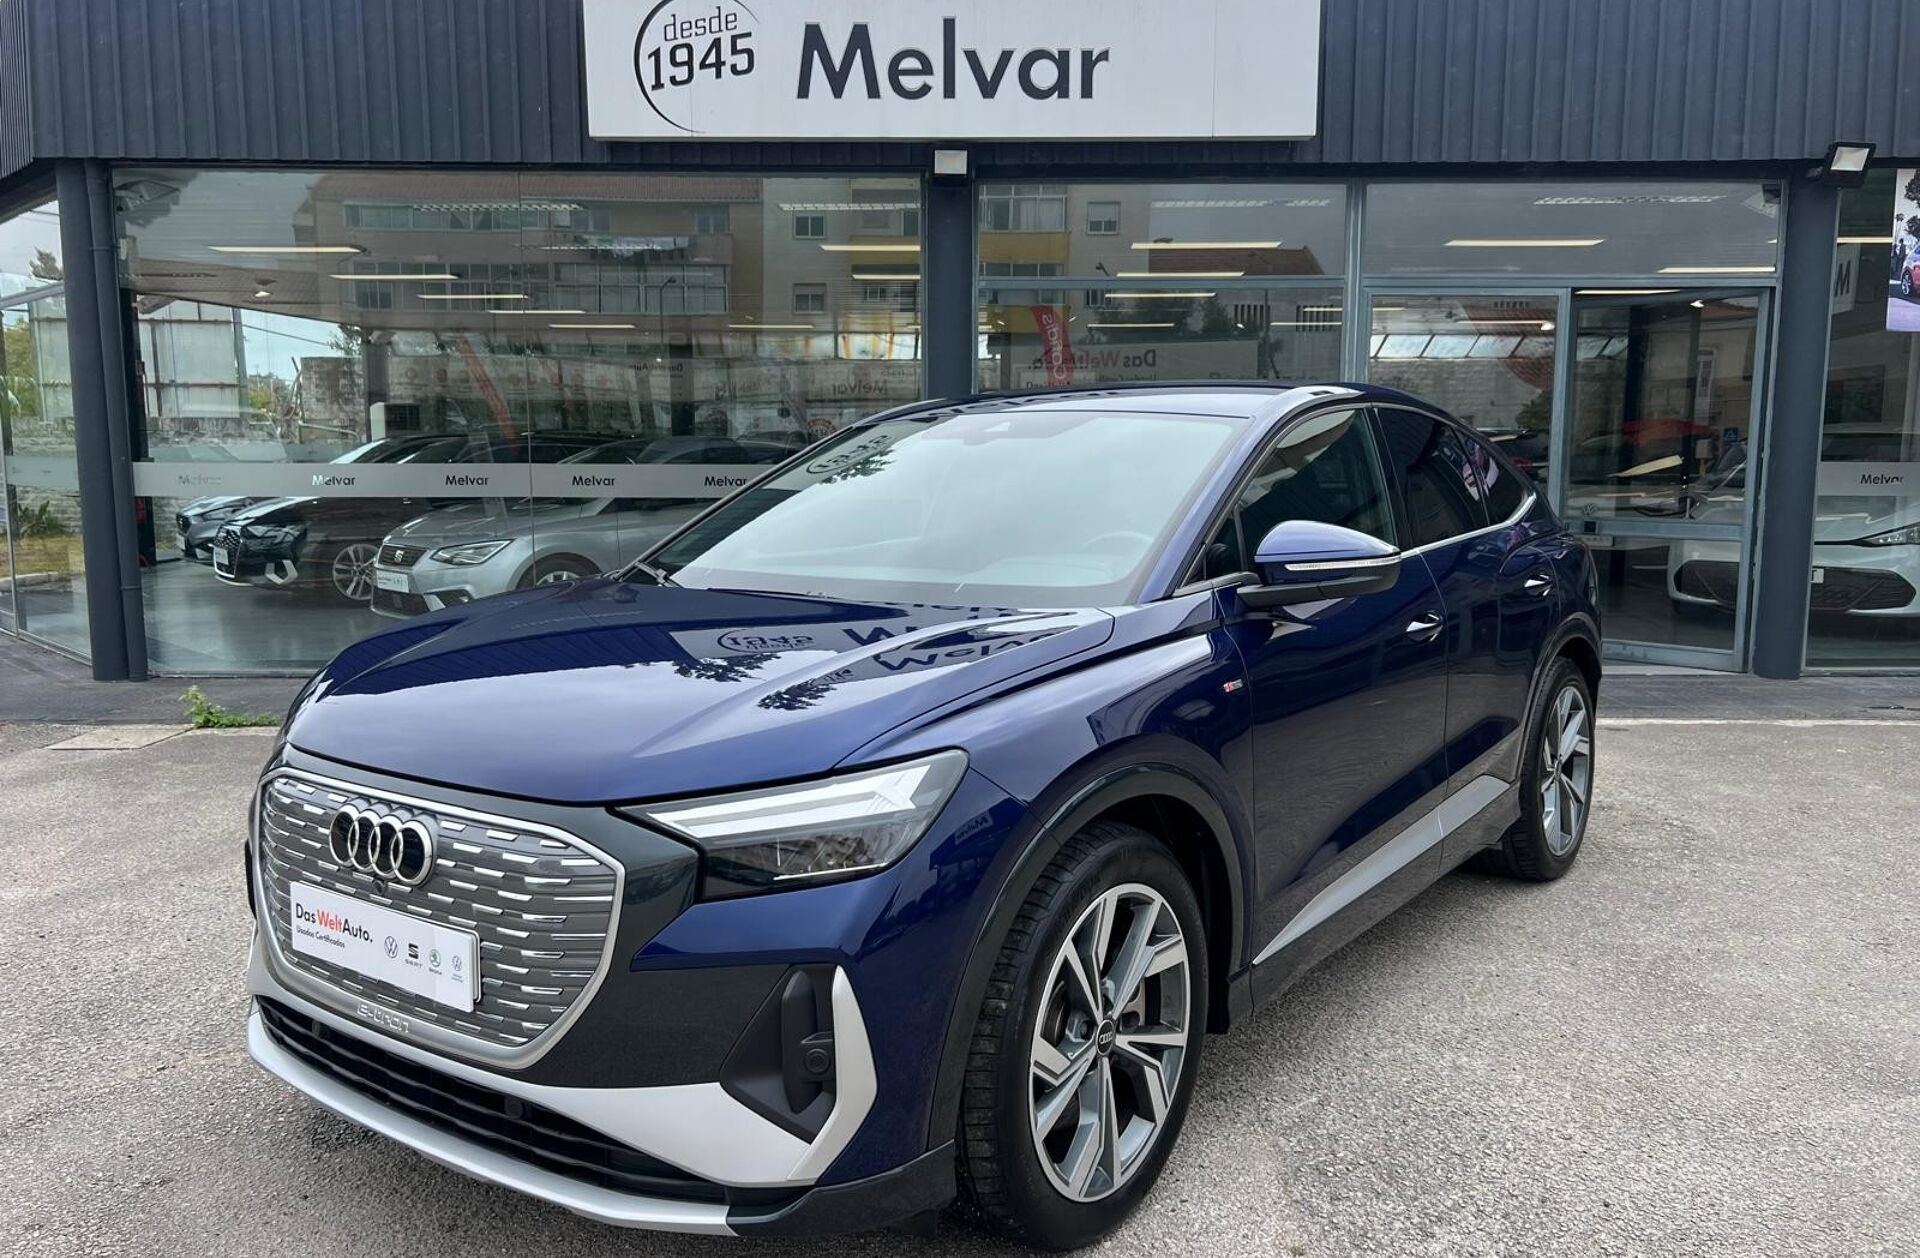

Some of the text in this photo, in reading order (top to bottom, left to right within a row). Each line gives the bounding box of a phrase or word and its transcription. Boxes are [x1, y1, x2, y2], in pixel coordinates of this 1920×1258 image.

[664, 6, 738, 41] desde
[647, 32, 755, 91] 1945
[797, 16, 1111, 100] Melvar
[312, 474, 356, 486] Melvar
[445, 475, 488, 486] Melvar
[572, 475, 616, 487] Melvar
[704, 476, 747, 487] Melvar
